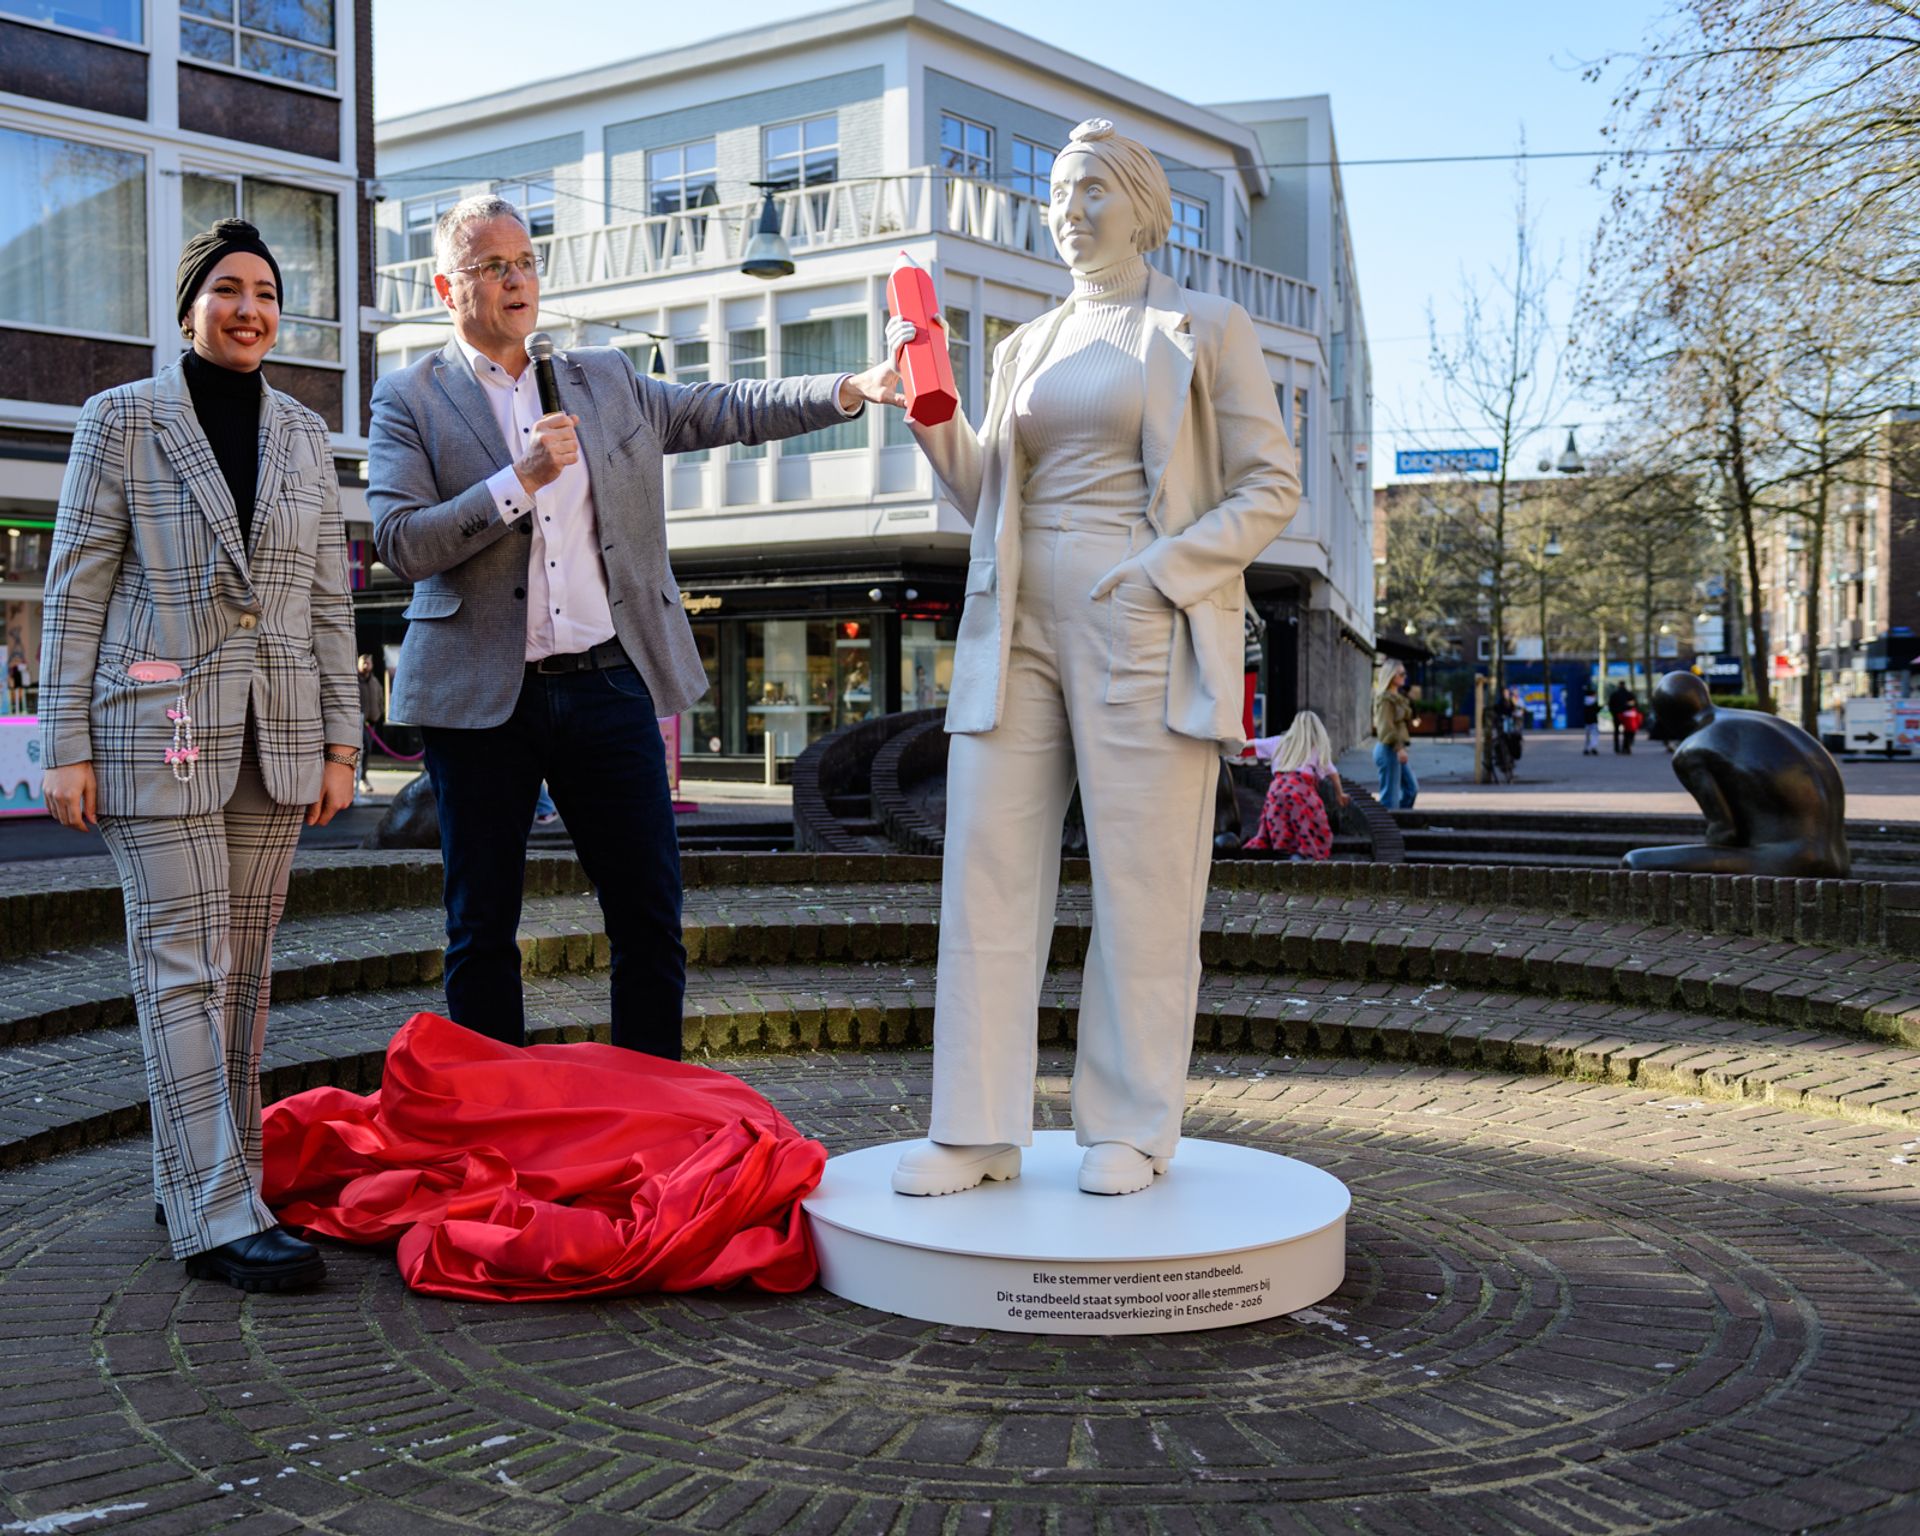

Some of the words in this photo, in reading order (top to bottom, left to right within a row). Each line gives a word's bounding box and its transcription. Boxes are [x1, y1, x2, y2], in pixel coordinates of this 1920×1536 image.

[1033, 1273, 1057, 1284] Elke
[1059, 1274, 1111, 1285] stemmer
[1113, 1272, 1161, 1285] verdient
[1163, 1273, 1183, 1282] een
[1185, 1264, 1243, 1281] standbeeld.
[997, 1291, 1013, 1302] Dit
[1016, 1293, 1080, 1305] standbeeld
[1082, 1295, 1112, 1305] staat
[1114, 1292, 1163, 1307] symbool
[1165, 1292, 1190, 1302] voor
[1192, 1288, 1211, 1300] alle
[1213, 1282, 1259, 1297] stemmers
[1260, 1278, 1271, 1291] bij
[1008, 1306, 1023, 1317] de
[1024, 1306, 1172, 1320] gemeenteraadsverkiezing
[1174, 1305, 1184, 1316] in
[1186, 1300, 1234, 1315] Enschede
[1240, 1294, 1263, 1308] 2026
